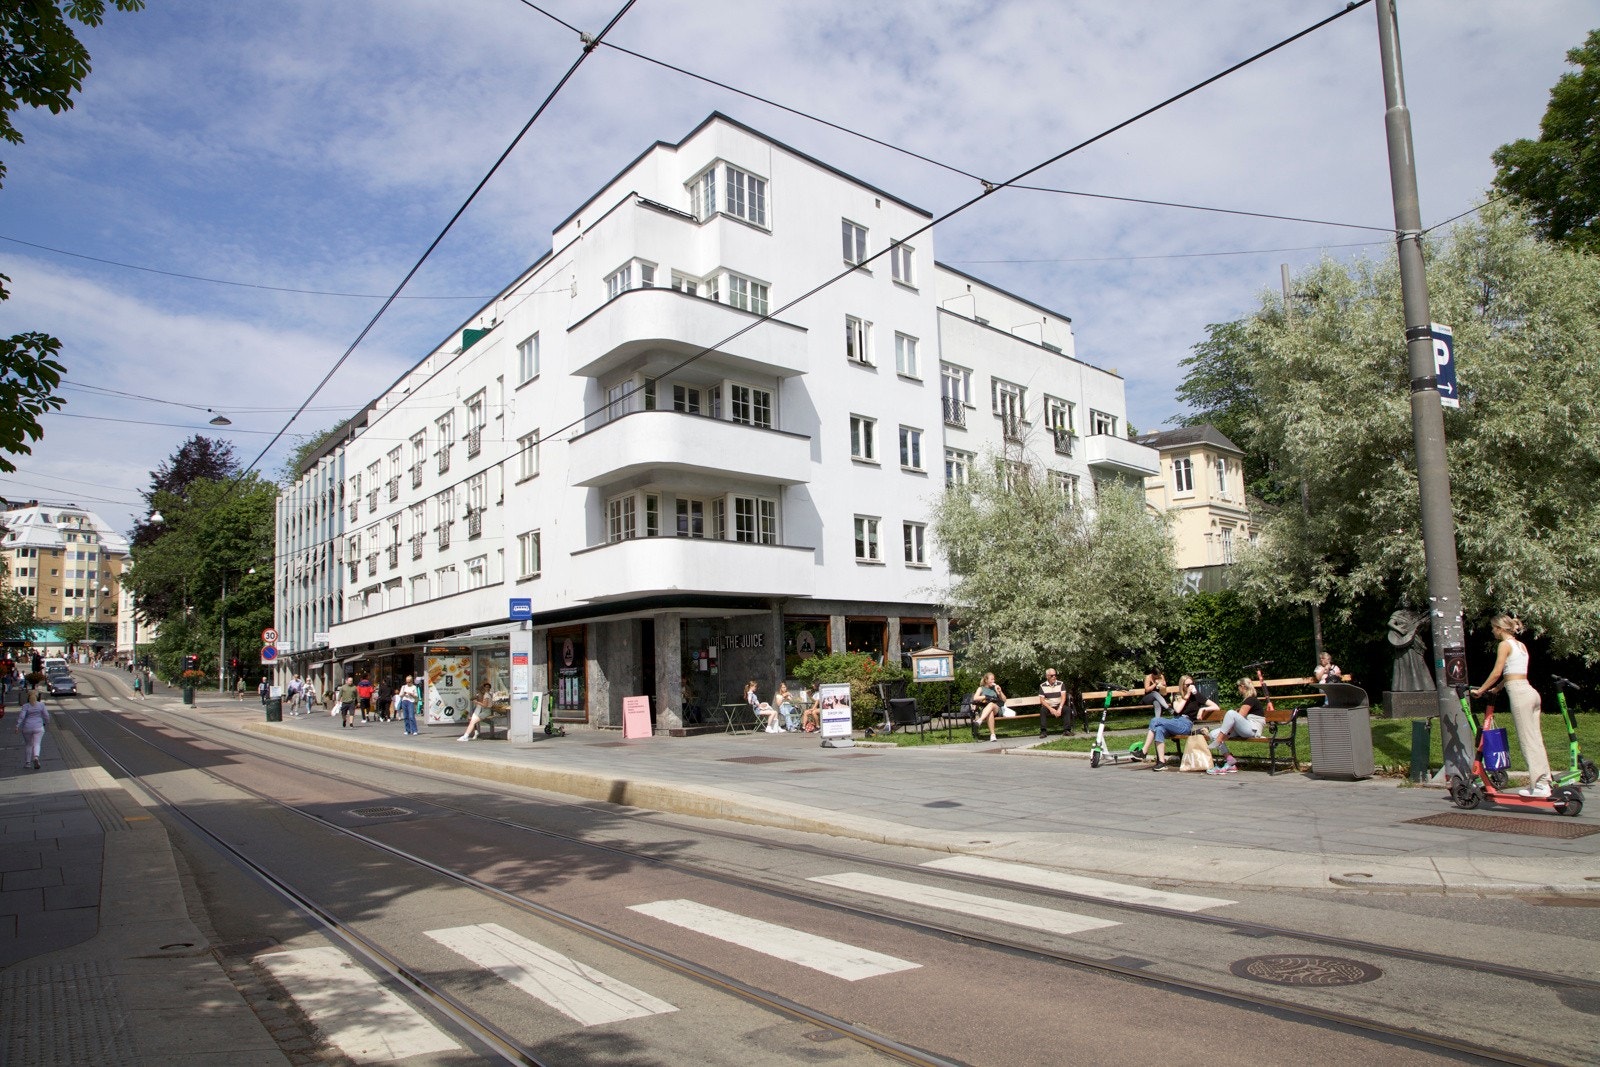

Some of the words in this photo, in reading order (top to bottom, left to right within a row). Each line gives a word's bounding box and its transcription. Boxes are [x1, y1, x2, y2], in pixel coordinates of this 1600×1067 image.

[1432, 338, 1450, 375] P
[265, 632, 275, 640] 30
[725, 635, 740, 649] THE
[742, 633, 763, 648] JUICE
